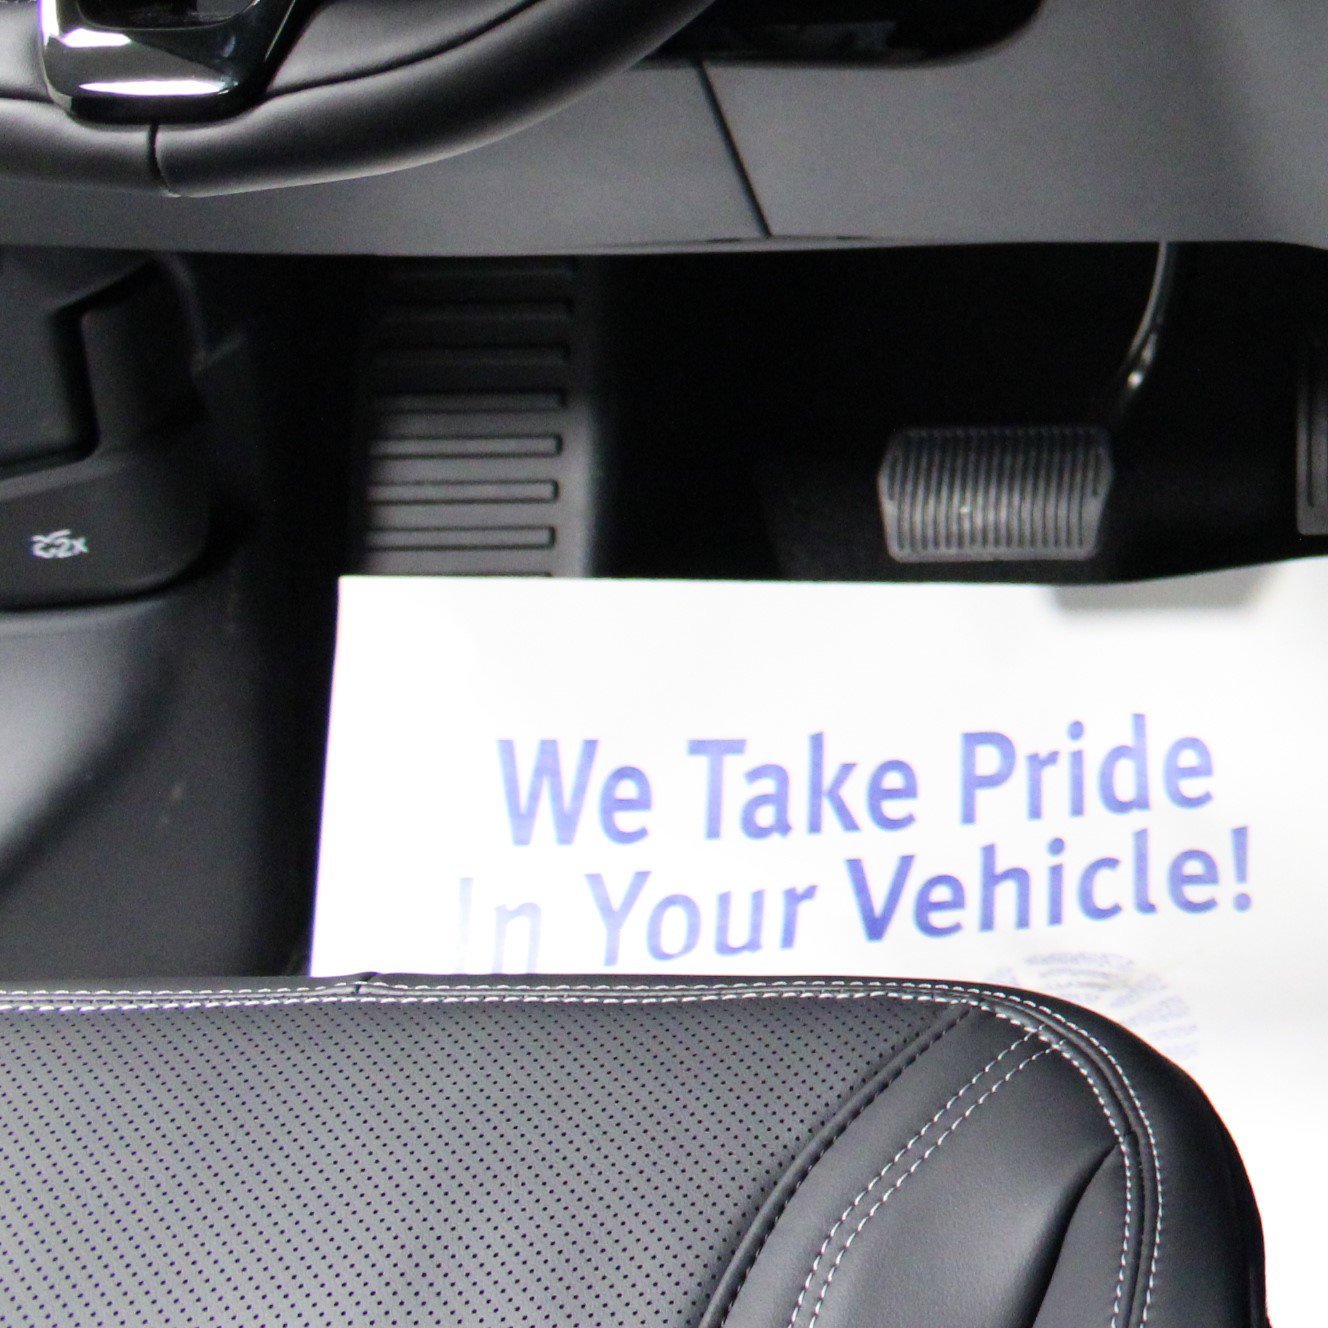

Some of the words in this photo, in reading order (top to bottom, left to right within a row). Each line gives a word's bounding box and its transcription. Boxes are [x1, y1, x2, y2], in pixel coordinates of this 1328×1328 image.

[496, 738, 653, 847] We
[687, 732, 919, 842] Take
[958, 713, 1214, 827] Pride
[456, 876, 541, 973] In
[585, 870, 819, 967] Your
[844, 826, 1252, 945] Vehicle!
